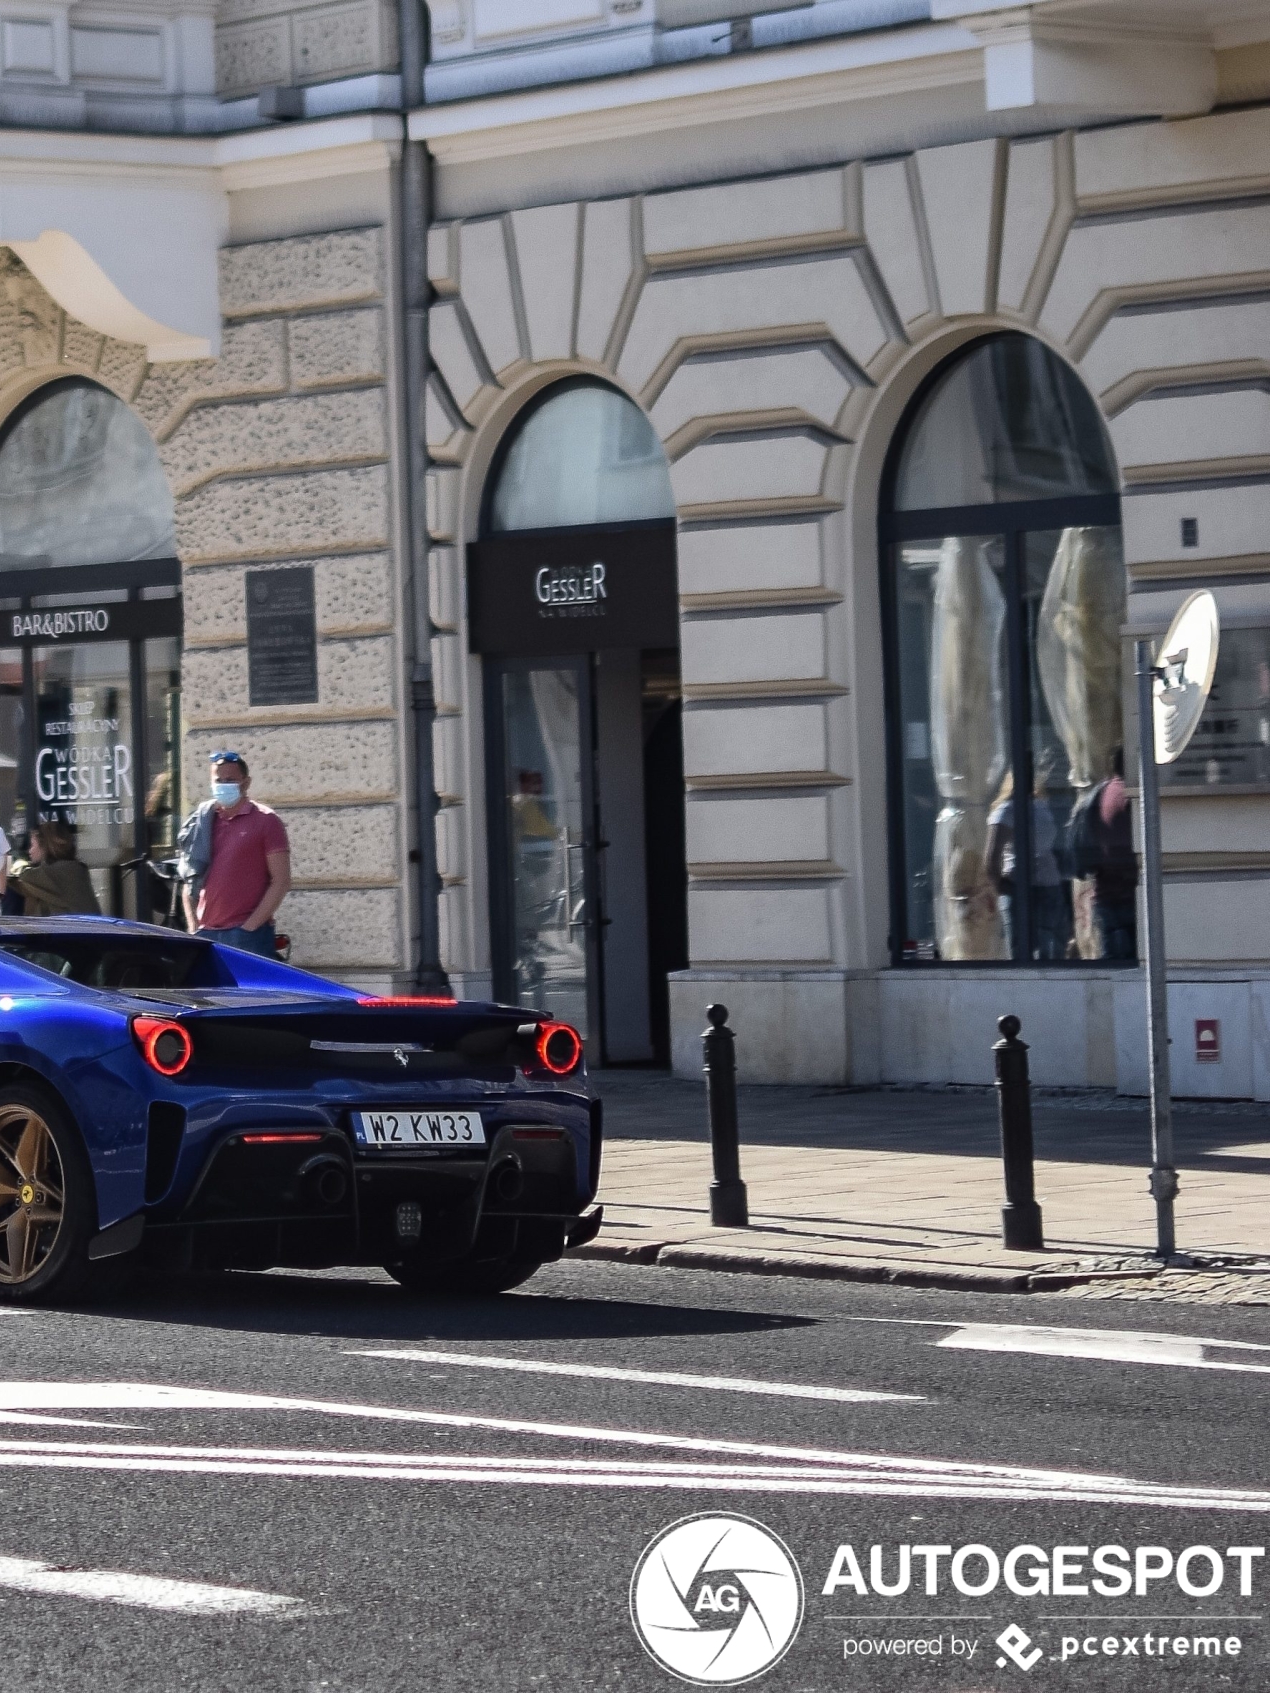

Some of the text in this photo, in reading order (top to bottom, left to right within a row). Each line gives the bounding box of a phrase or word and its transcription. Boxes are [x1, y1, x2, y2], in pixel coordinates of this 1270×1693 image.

[536, 563, 607, 603] GESSLER
[13, 609, 109, 638] BAR&BISTRO
[35, 744, 133, 802] GESSLER
[369, 1114, 472, 1142] W2 KW33
